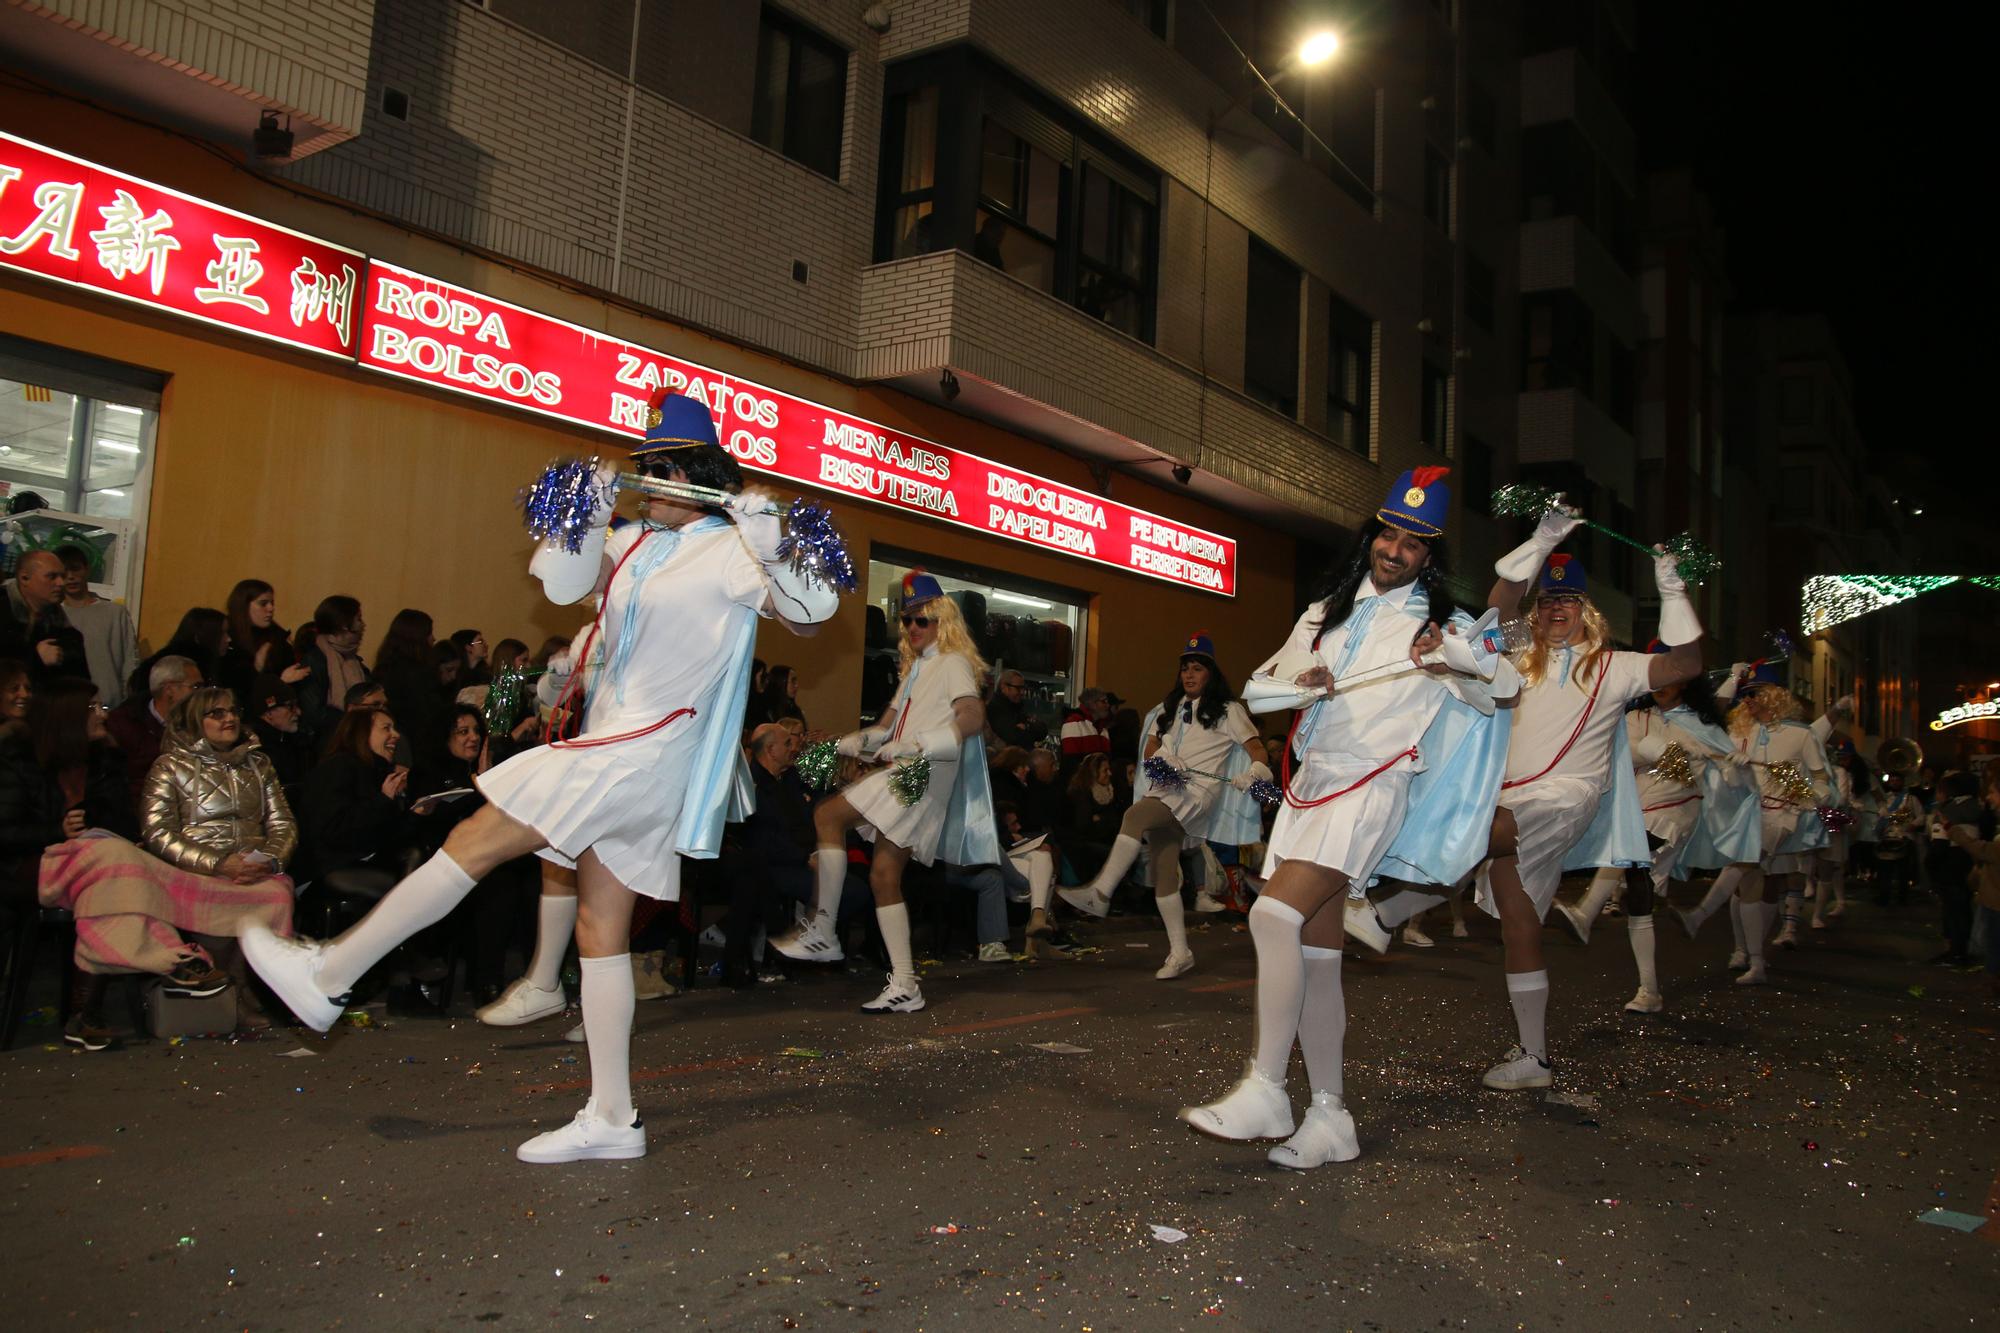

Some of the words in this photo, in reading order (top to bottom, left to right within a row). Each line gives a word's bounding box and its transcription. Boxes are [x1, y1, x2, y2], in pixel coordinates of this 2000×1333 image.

[90, 189, 354, 347] 新亚洲
[376, 277, 511, 349] ROPA
[371, 324, 562, 405] BOLSOS
[615, 353, 779, 429] ZAPATOS
[609, 392, 777, 465] REOS
[822, 419, 950, 480] MENAJES
[819, 454, 959, 516] BISUTERIA
[987, 472, 1107, 530] DROGUERIA
[988, 505, 1096, 555] PAPELERIA
[1129, 516, 1226, 565] PERFUMERIA
[1130, 543, 1224, 589] FERRETERIA
